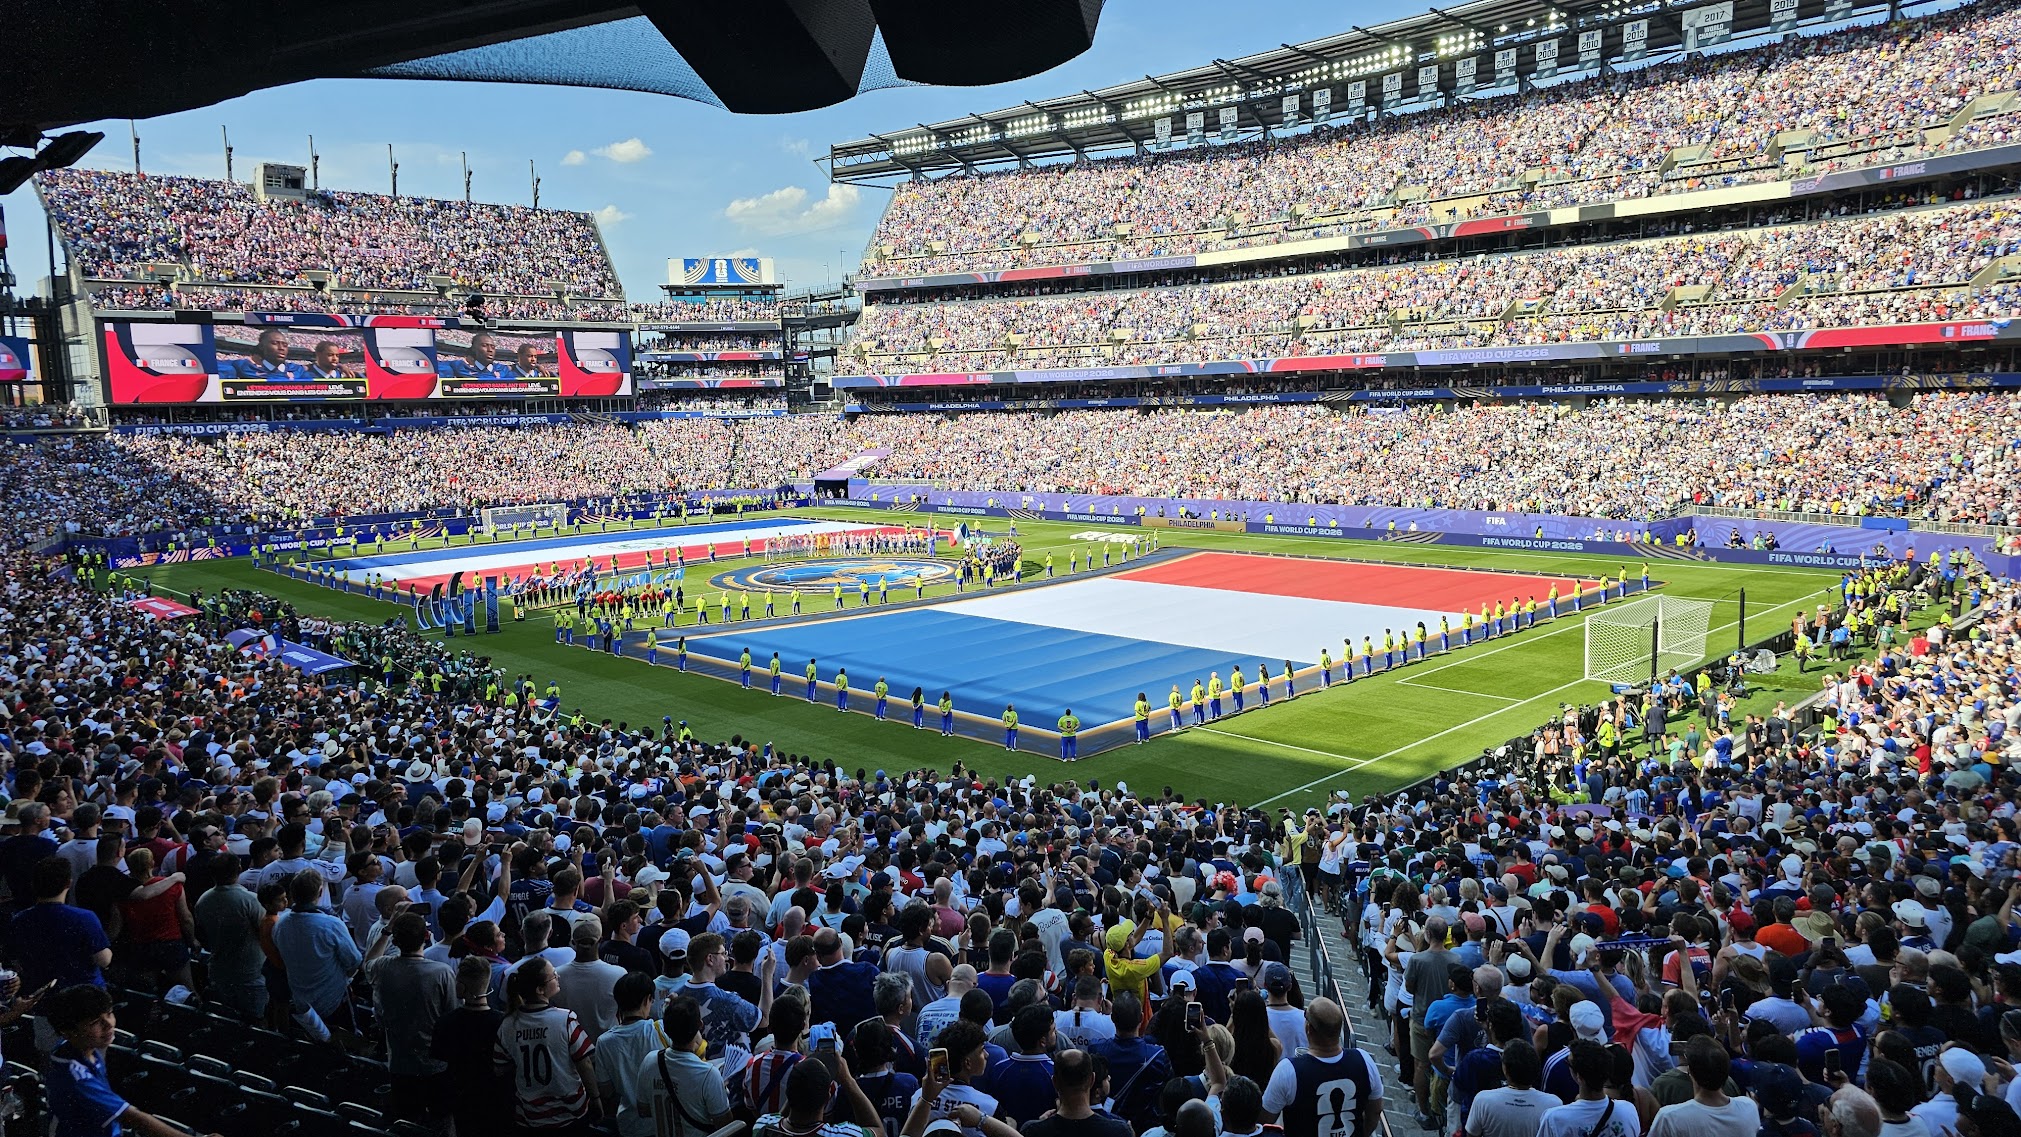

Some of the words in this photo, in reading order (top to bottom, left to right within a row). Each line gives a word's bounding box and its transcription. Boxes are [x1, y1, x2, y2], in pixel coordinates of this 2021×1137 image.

[1774, 0, 1795, 9] 2019
[1704, 11, 1725, 22] 2017
[1703, 23, 1724, 32] WORLD
[1626, 30, 1645, 40] 2013
[1697, 27, 1730, 41] CHAMPIONS
[1581, 40, 1598, 50] 2010
[1537, 49, 1556, 59] 2006
[1496, 58, 1514, 68] 2004
[1457, 66, 1475, 76] 2003
[1420, 74, 1437, 83] 2002
[1385, 81, 1400, 91] 2001
[1893, 162, 1926, 180] FRANCE
[1514, 217, 1533, 227] FRANCE
[1371, 235, 1387, 244] FRANCE
[1127, 261, 1142, 270] FIFA
[1143, 260, 1168, 269] WORLD
[1171, 259, 1185, 267] CUP
[1186, 258, 1196, 266] 2
[1073, 265, 1092, 274] FRANCE
[907, 278, 924, 286] FRANCE
[274, 315, 294, 323] FRANCE
[429, 319, 446, 327] FRANCE
[1961, 324, 1999, 336] FRANCE
[1631, 342, 1660, 353] FRANCE
[1440, 353, 1459, 361] FIFA
[1459, 351, 1493, 361] WORLD
[1494, 350, 1513, 359] CUP
[1514, 348, 1549, 357] 2026
[151, 359, 178, 367] FRANCE
[585, 359, 604, 367] FRANCE
[1365, 356, 1387, 364] FRANCE
[1049, 370, 1073, 378] WORLD
[1074, 370, 1088, 378] CUP
[1089, 369, 1114, 377] 2026
[1164, 365, 1182, 374] FRANCE
[1542, 384, 1625, 394] PHILADELPHIA
[1223, 394, 1279, 402] PHILADELPHIA
[448, 418, 468, 427] FIFA
[500, 416, 518, 424] CUP
[519, 415, 548, 424] 2026
[135, 427, 161, 436] FIFA
[206, 424, 228, 433] CUP
[230, 423, 270, 433] 2026
[1168, 519, 1215, 529] PHILADELPHIA
[1486, 516, 1507, 525] FIFA
[1280, 525, 1303, 534] WORLD
[1304, 527, 1317, 535] CUP
[1318, 528, 1343, 536] 2026
[309, 539, 325, 547] CUP
[1482, 537, 1500, 546] FIFA
[1501, 538, 1532, 548] WORLD
[1533, 540, 1551, 549] CUP
[1551, 541, 1584, 550] 2026
[1768, 553, 1793, 563] FIFA
[1793, 554, 1835, 566] WORLD
[1836, 556, 1860, 567] CUP
[1664, 801, 1674, 814] 10
[511, 902, 530, 926] 10
[516, 1027, 549, 1042] PULISIC
[520, 1043, 553, 1088] 10
